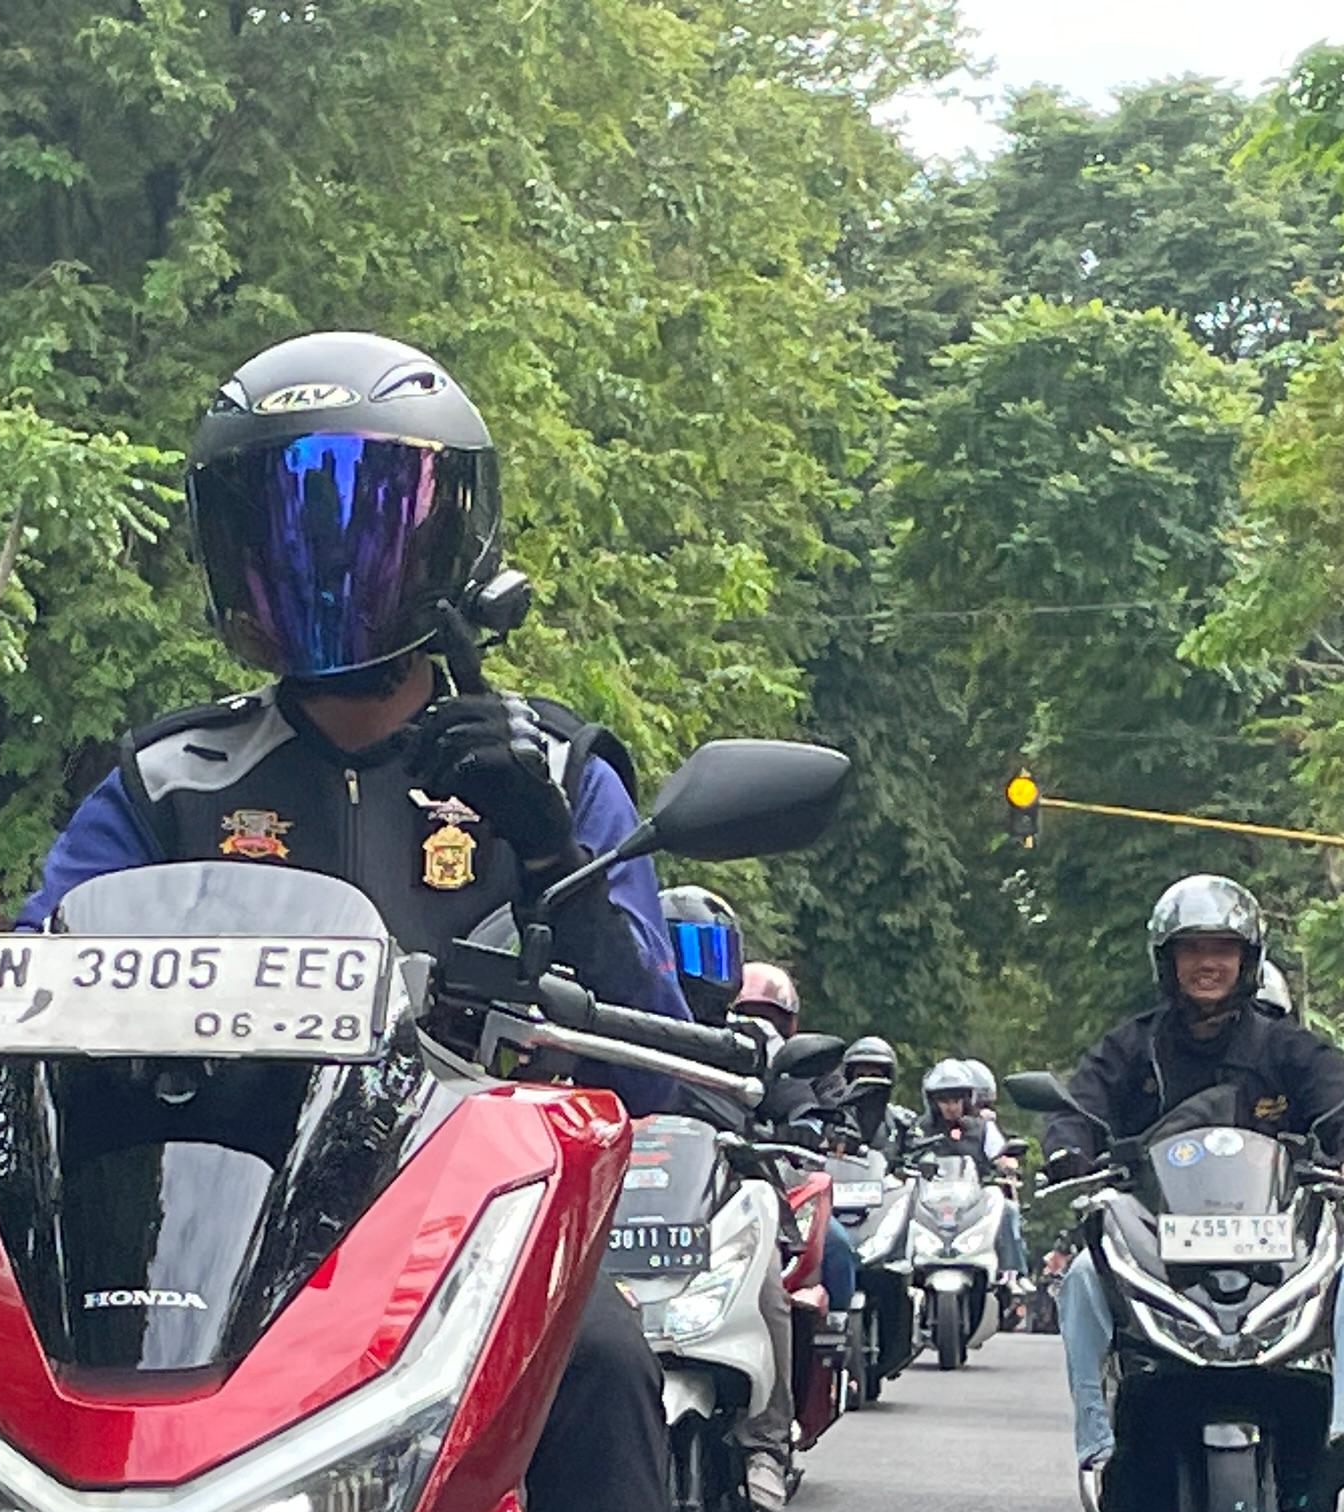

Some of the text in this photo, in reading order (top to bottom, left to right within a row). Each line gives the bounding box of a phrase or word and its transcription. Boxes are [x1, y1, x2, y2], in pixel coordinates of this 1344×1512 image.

[72, 946, 222, 990] 3905
[255, 946, 366, 991] EEG
[83, 1289, 208, 1310] HONDA
